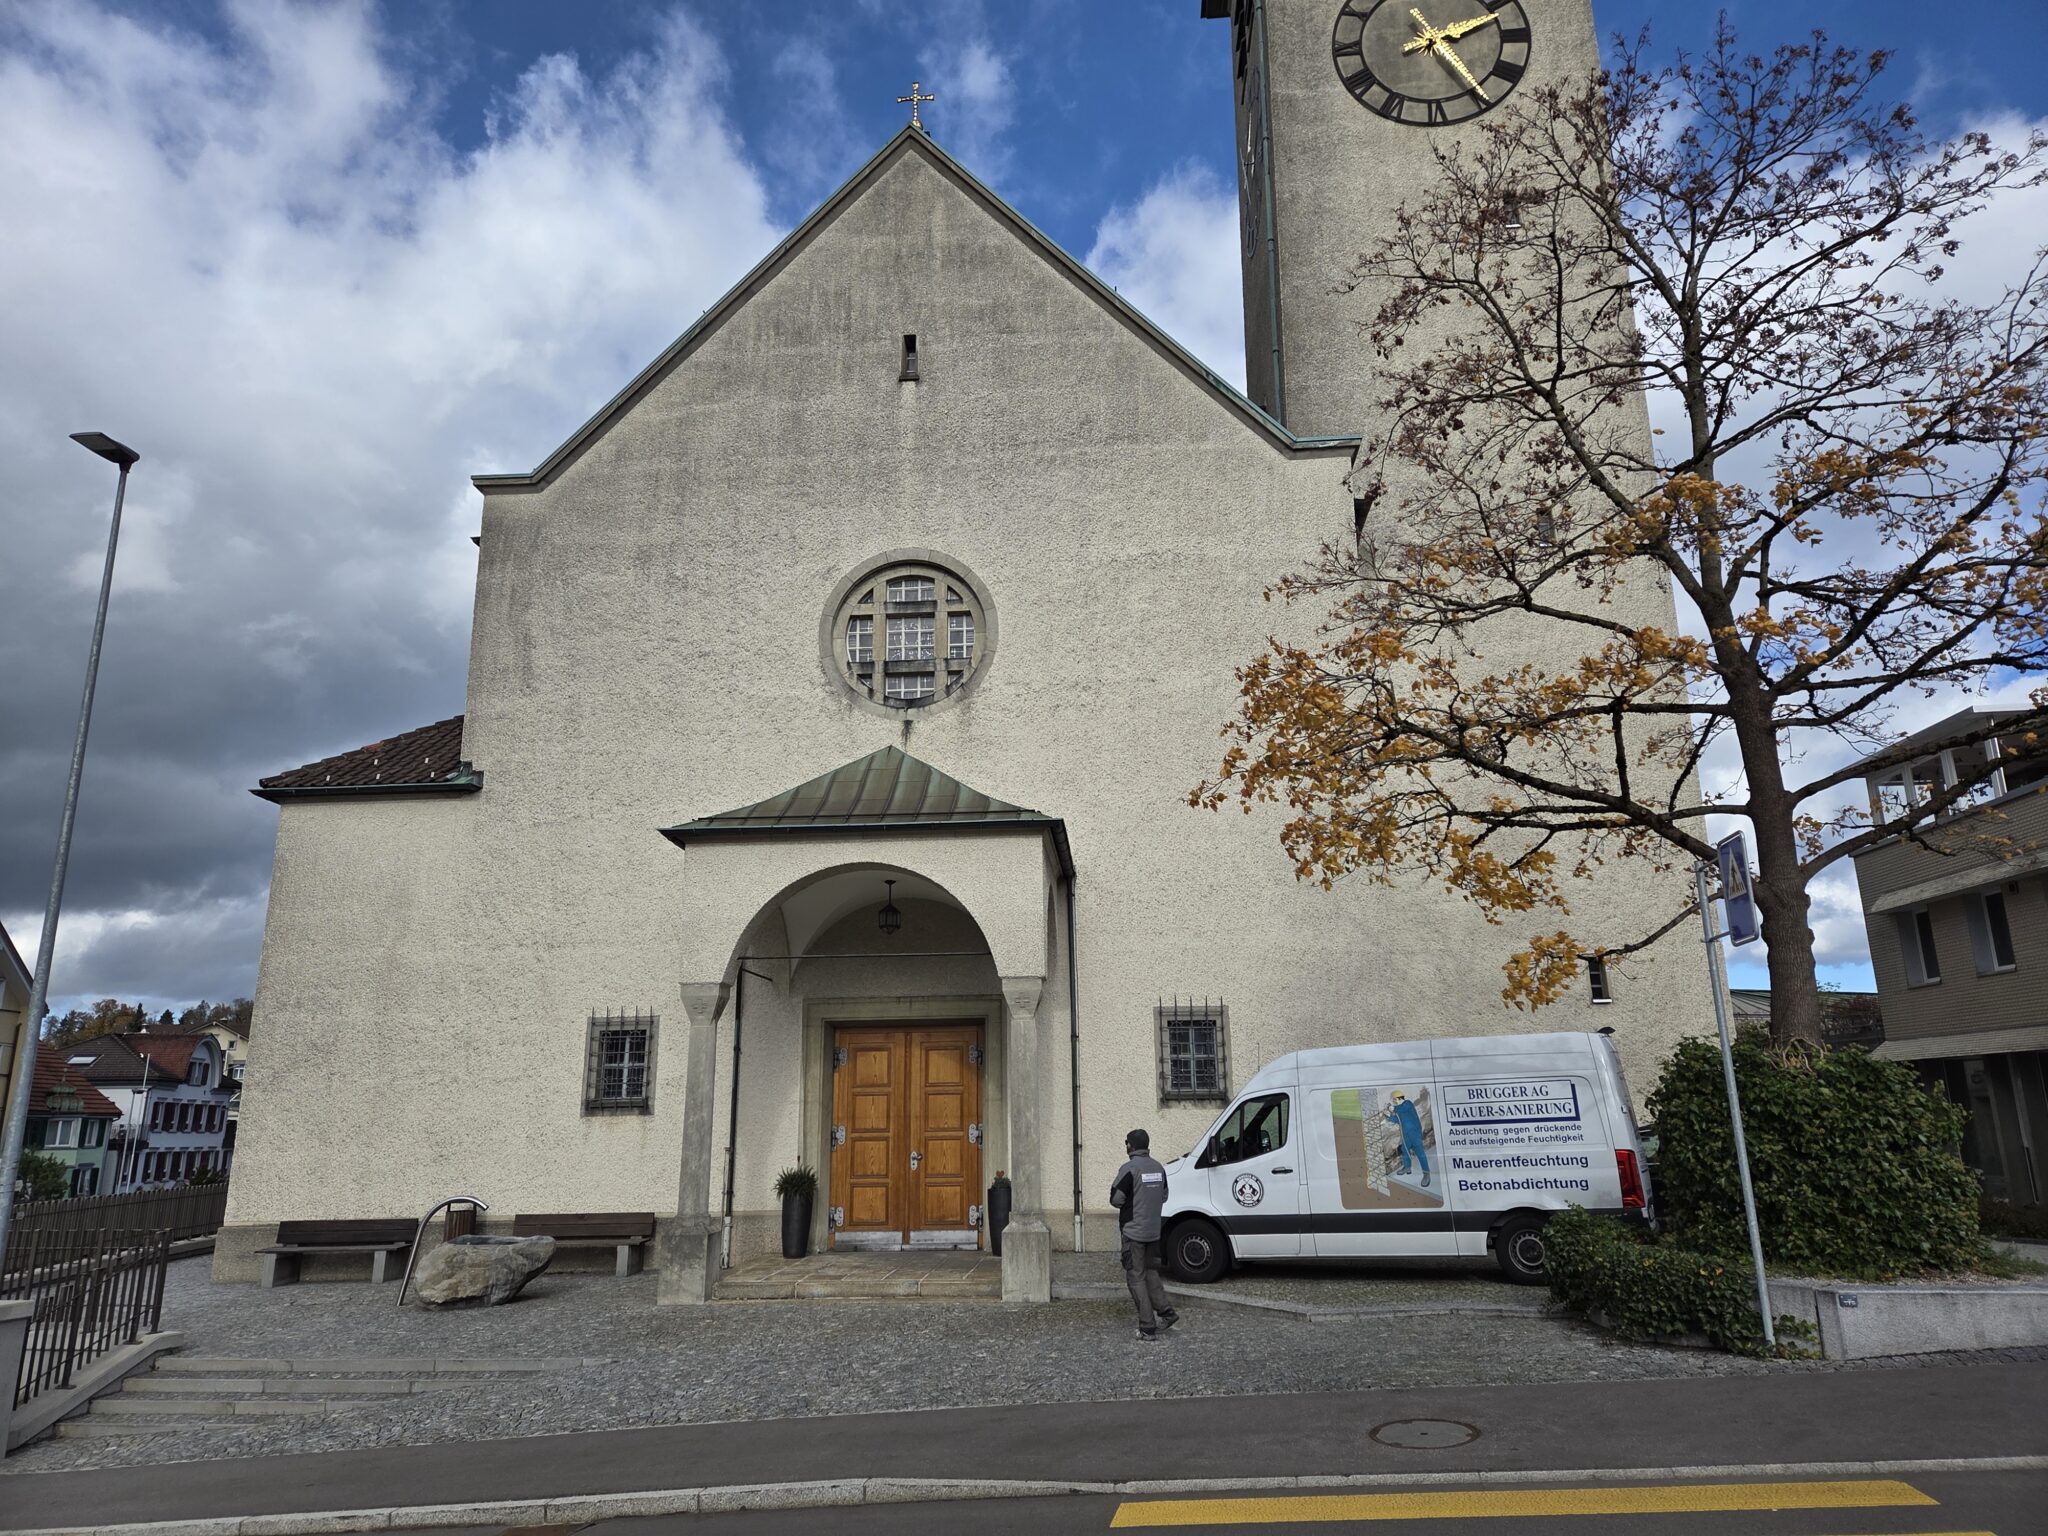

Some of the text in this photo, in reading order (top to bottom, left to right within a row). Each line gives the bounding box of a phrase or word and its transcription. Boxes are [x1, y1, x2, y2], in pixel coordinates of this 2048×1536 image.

[1467, 1085, 1549, 1100] BRUGGER AG
[1450, 1102, 1572, 1119] MAUER-SANIERUNG
[1449, 1123, 1582, 1136] Abdichtung gegen drückende
[1450, 1133, 1584, 1146] und aufsteigende Feuchtigkeit
[1452, 1155, 1589, 1169] Mauerentfeuchtung
[1458, 1178, 1589, 1191] Betonabdichtung
